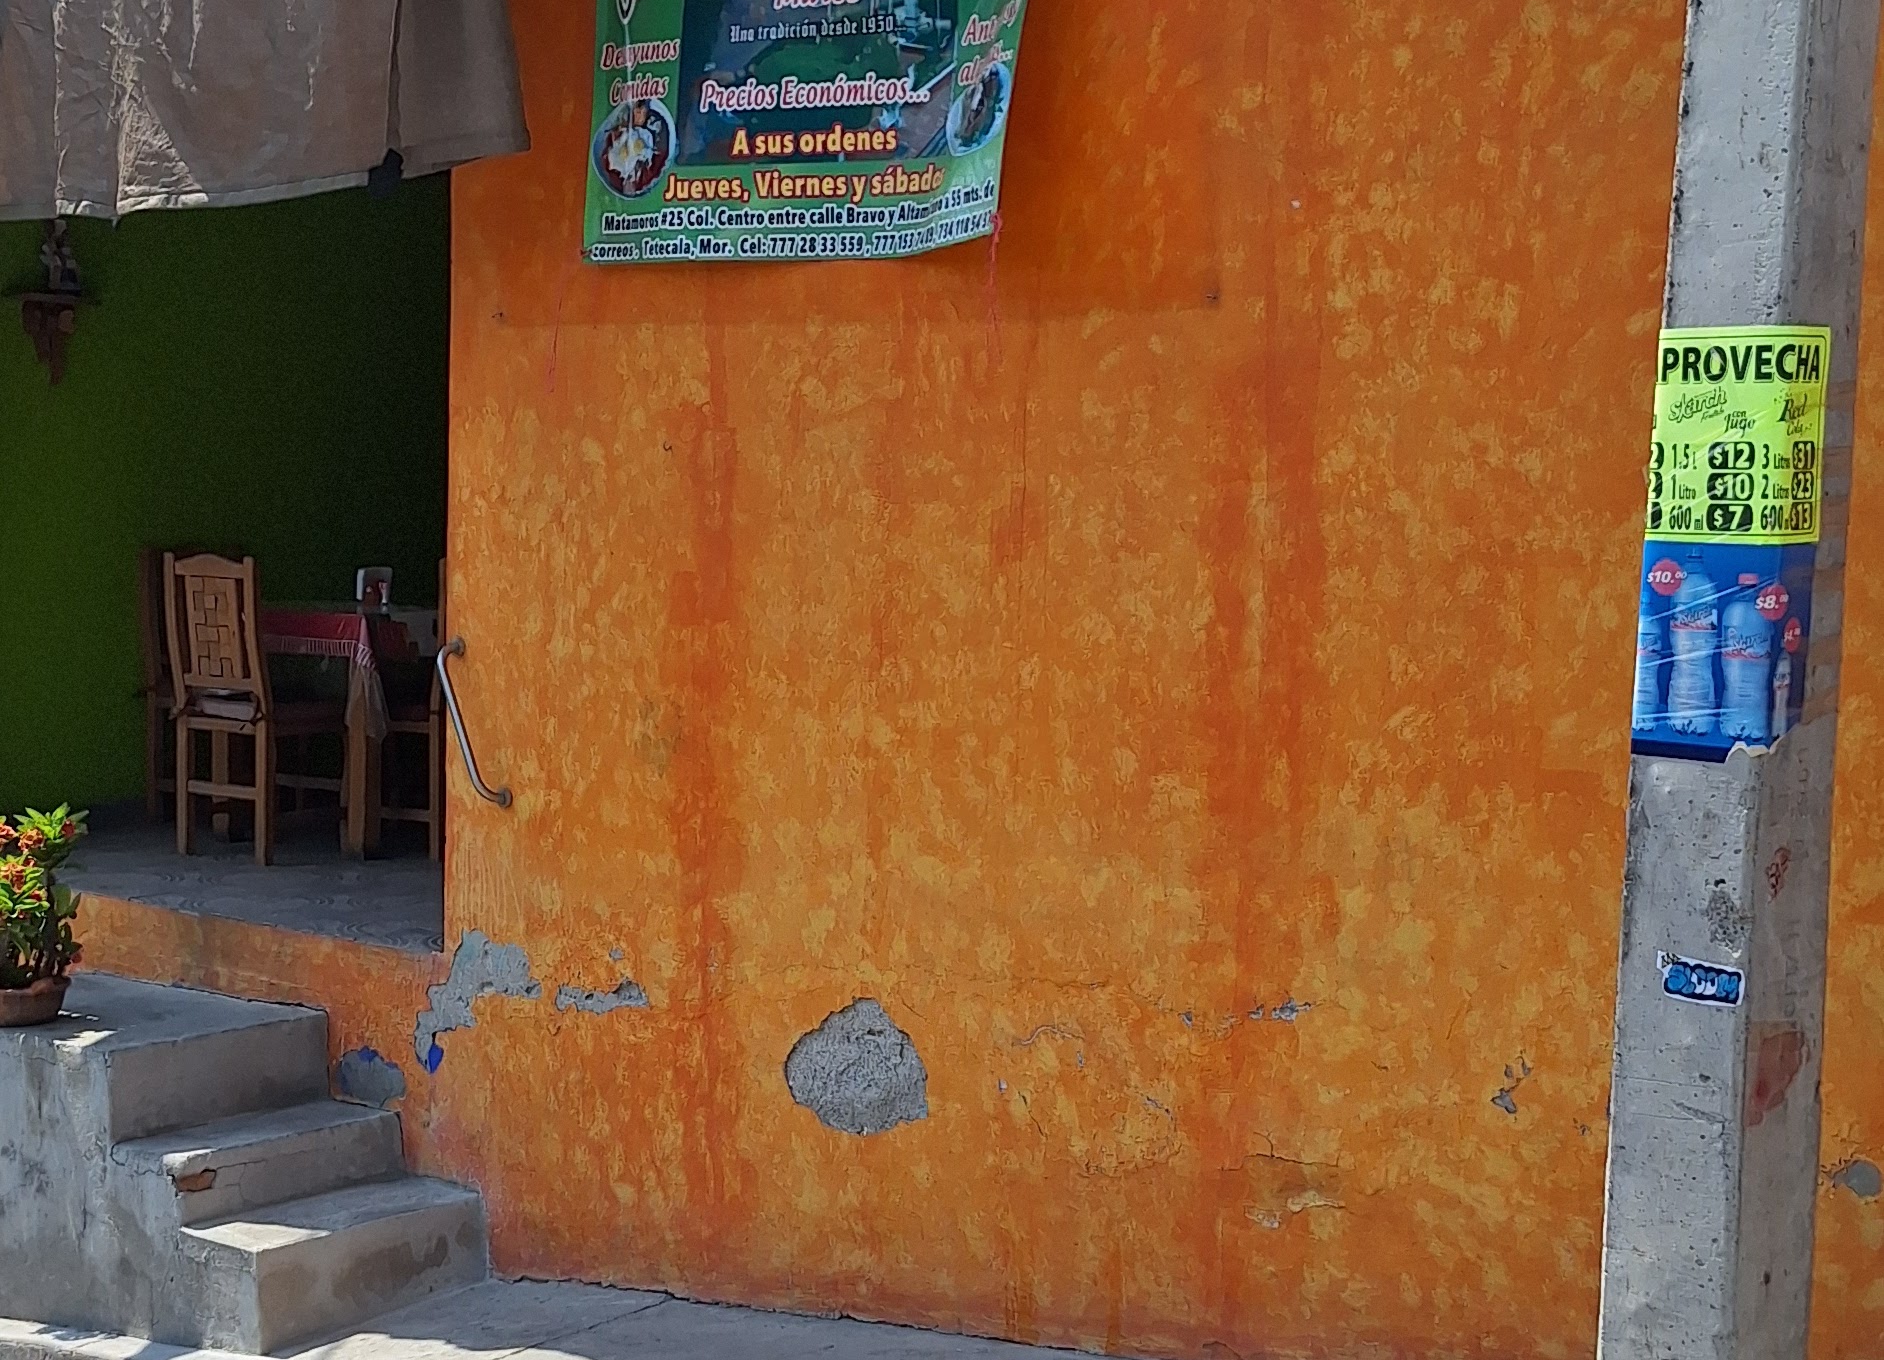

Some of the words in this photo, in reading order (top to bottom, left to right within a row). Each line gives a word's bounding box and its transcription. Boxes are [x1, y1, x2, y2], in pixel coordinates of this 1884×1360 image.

[757, 19, 817, 41] tradición
[820, 17, 858, 37] desde
[602, 42, 678, 69] Deyunos
[701, 78, 777, 111] Precios
[732, 129, 750, 155] A
[756, 134, 794, 155] sus
[800, 124, 898, 153] ordenes
[664, 174, 749, 201] Jueves,
[755, 170, 847, 198] Viernes
[852, 175, 867, 203] y
[604, 214, 659, 232] Matamoros
[661, 211, 684, 227] #25
[687, 209, 714, 227] Col.
[718, 209, 765, 227] Centro
[768, 207, 806, 226] entre
[810, 206, 843, 224] calle
[847, 207, 885, 224] Bravo
[886, 209, 896, 228] y
[644, 237, 695, 257] Tetecala,
[699, 238, 733, 255] Mor.
[1656, 343, 1820, 383] PROVECHA
[1713, 442, 1751, 469] $12
[1761, 443, 1770, 470] 3
[1671, 473, 1677, 500] 1
[1678, 483, 1697, 500] Litro
[1714, 473, 1750, 500] $10
[1760, 473, 1769, 500] 2
[1668, 504, 1692, 531] 600
